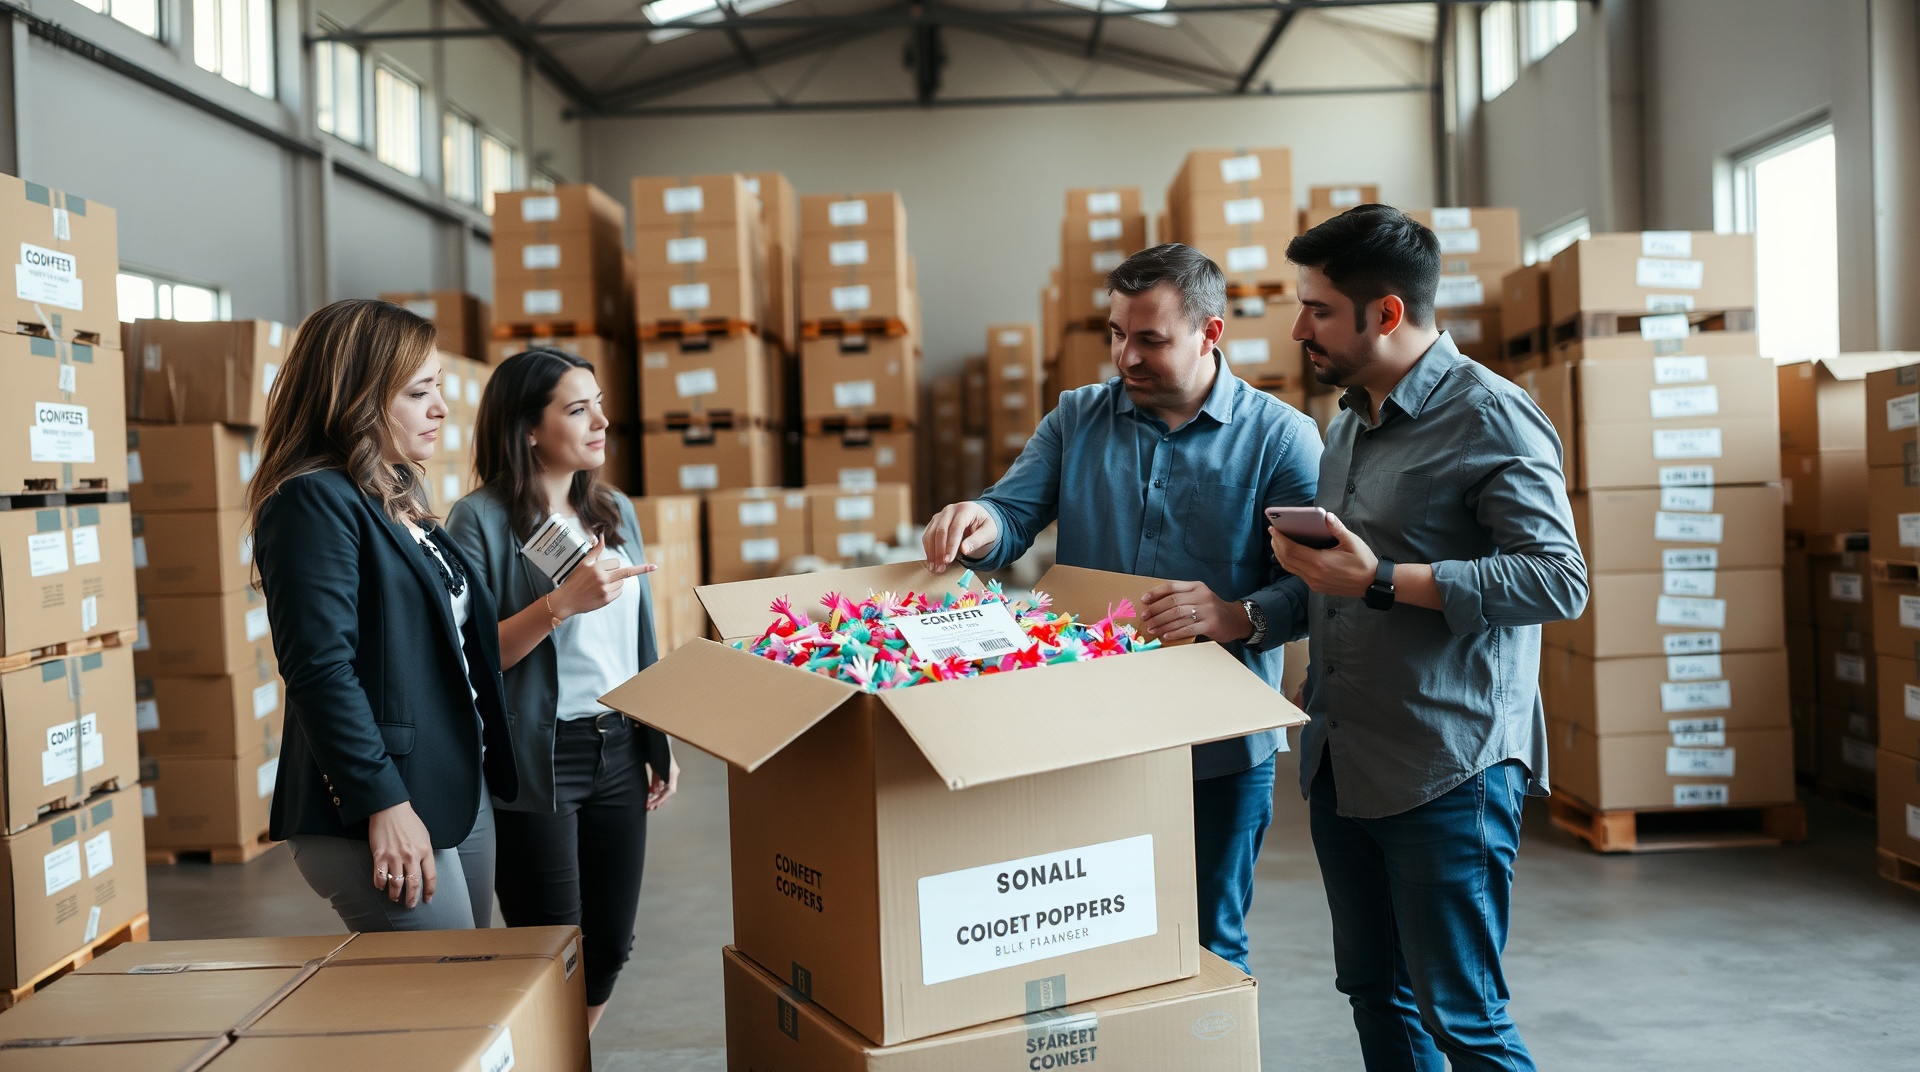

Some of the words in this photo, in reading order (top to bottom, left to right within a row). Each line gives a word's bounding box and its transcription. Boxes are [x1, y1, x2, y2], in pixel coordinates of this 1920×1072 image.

[996, 858, 1087, 894] SONALL
[956, 914, 1031, 946] COIOET
[1036, 894, 1126, 930] POPPERS
